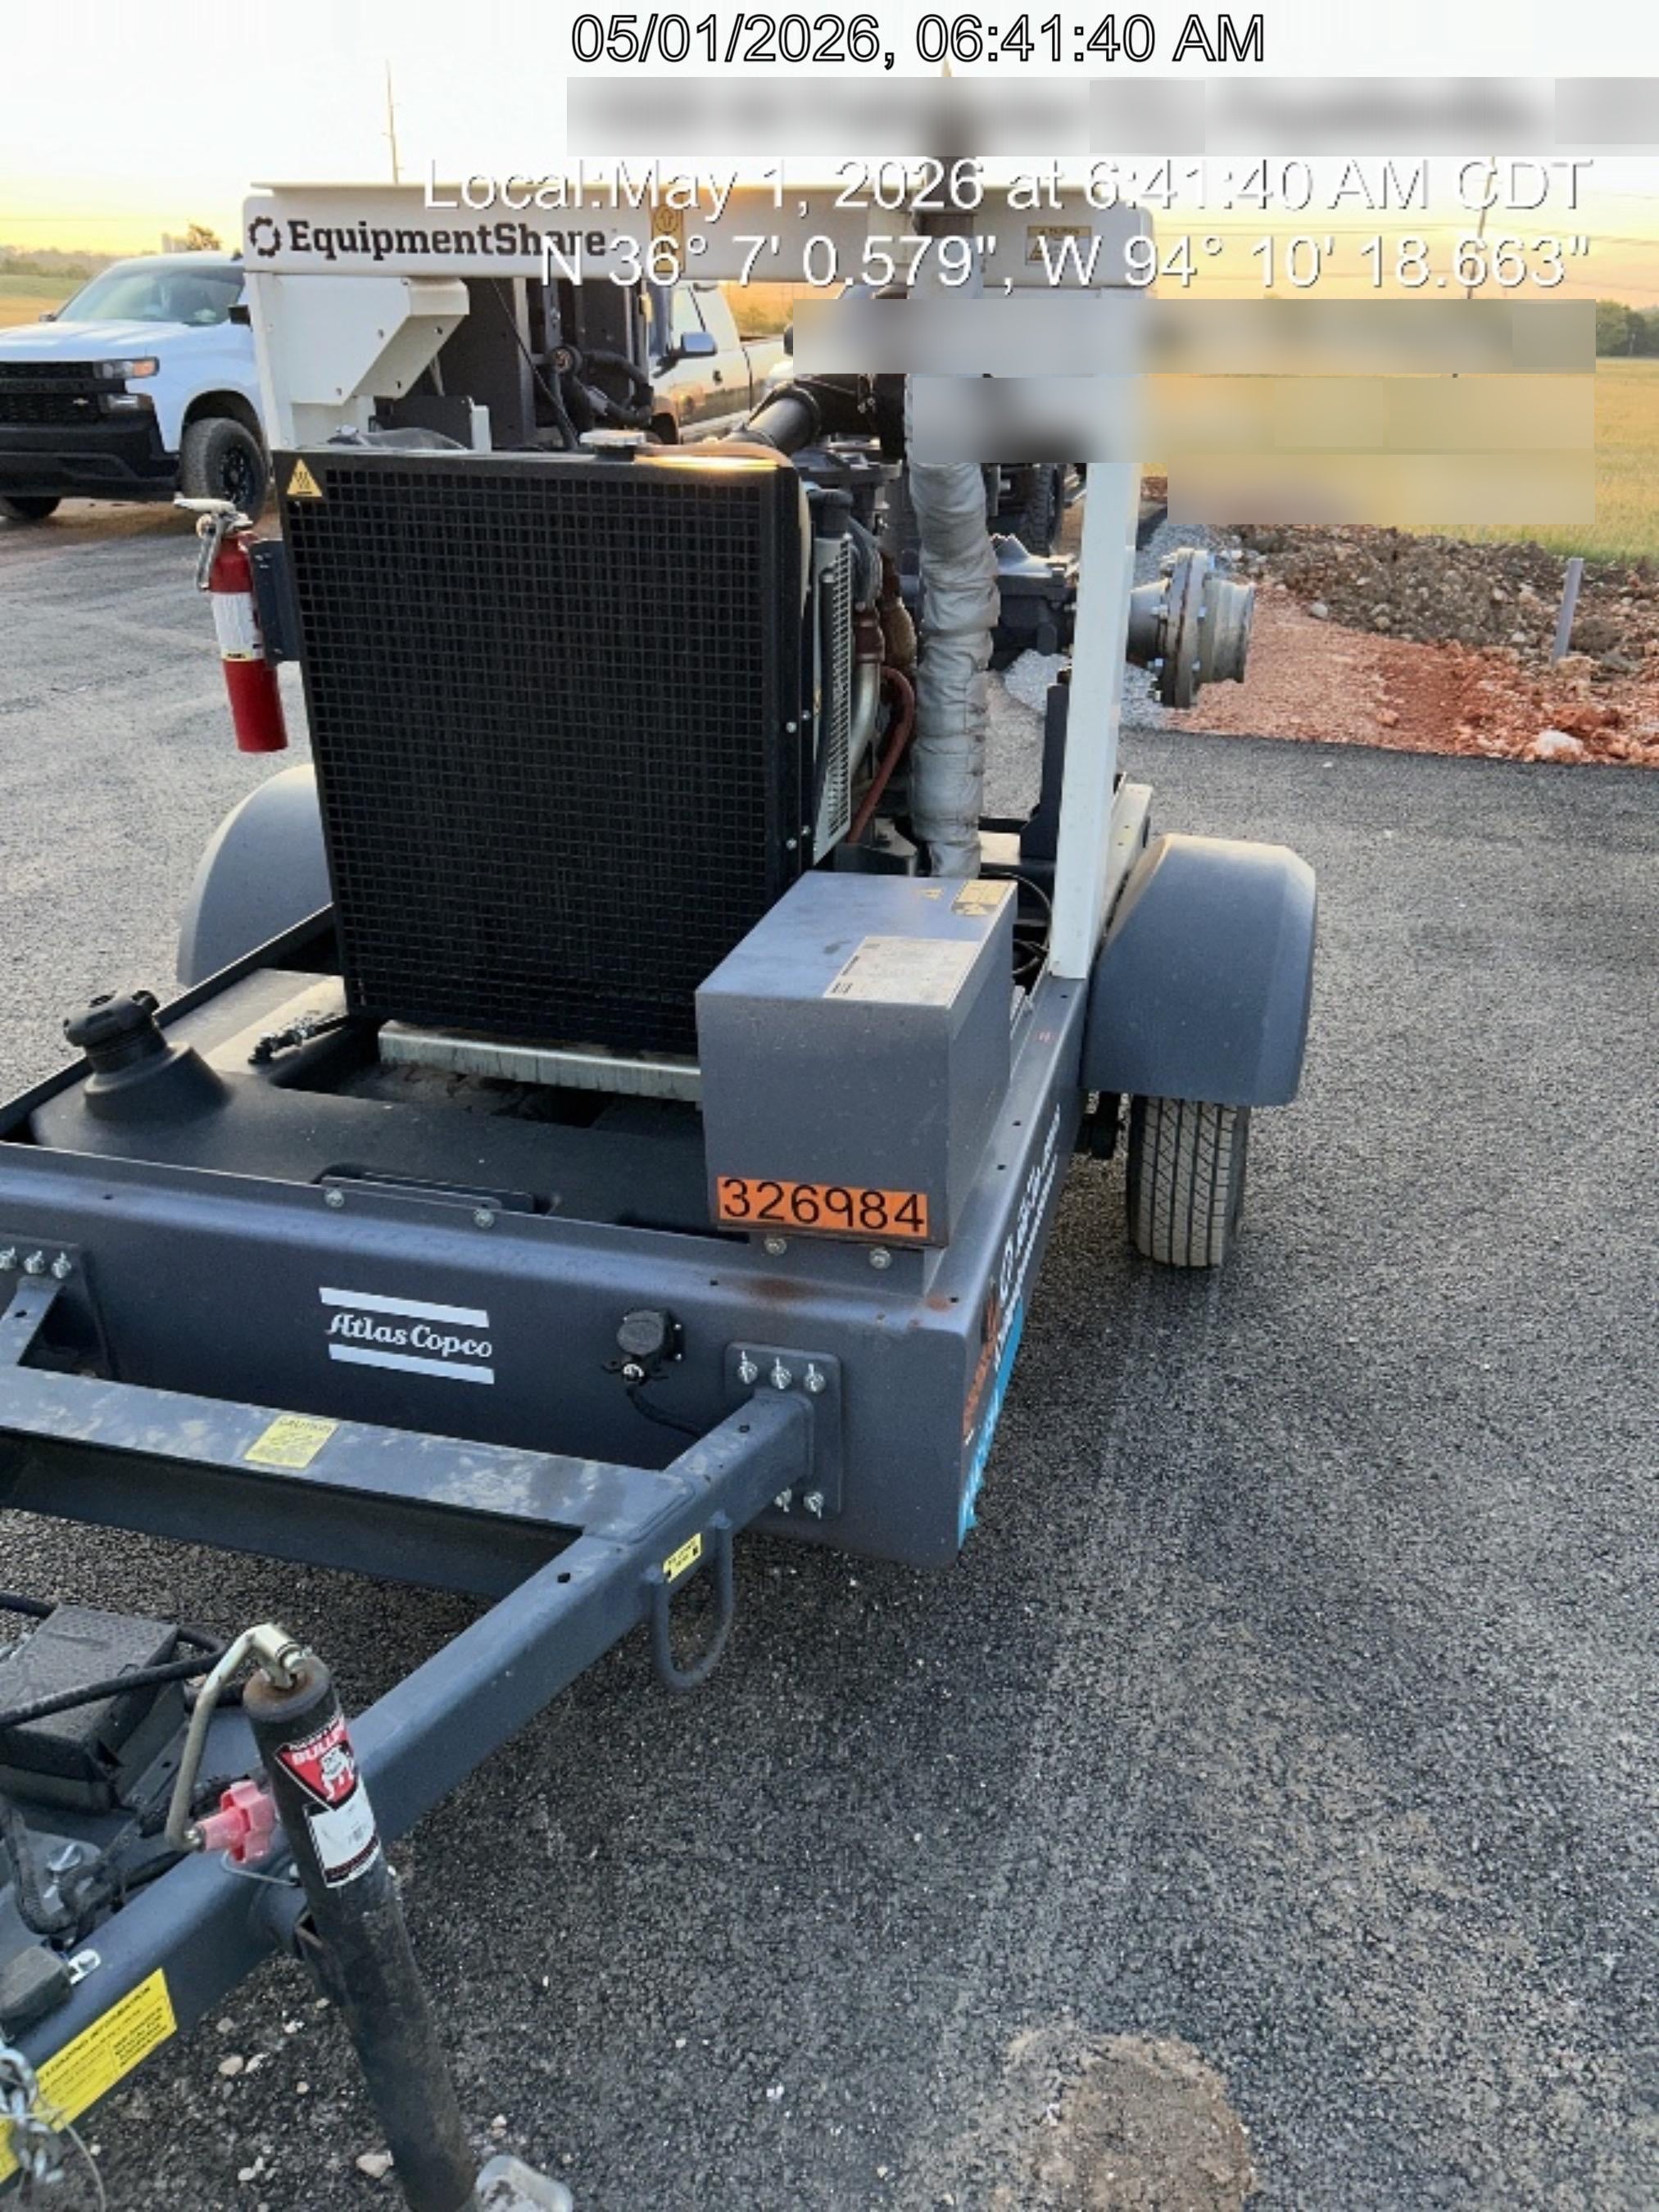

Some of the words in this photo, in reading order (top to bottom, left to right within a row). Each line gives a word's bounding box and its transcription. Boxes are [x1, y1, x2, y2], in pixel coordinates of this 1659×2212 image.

[288, 220, 606, 261] EquipmentShare
[723, 1177, 926, 1234] 326984
[325, 1312, 409, 1346] Atlas
[410, 1324, 492, 1358] Copco
